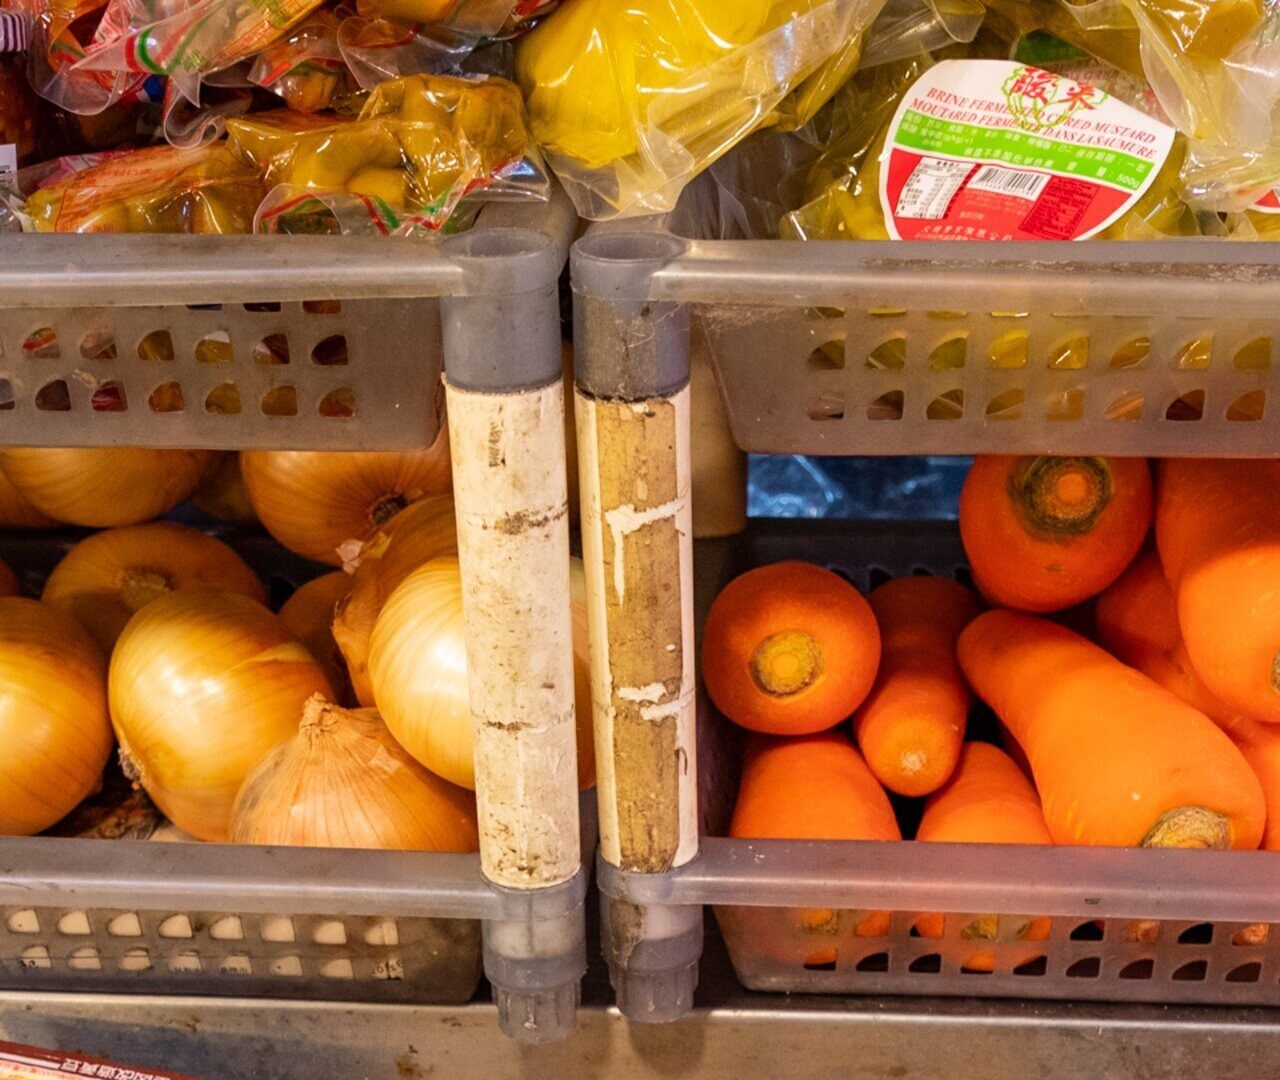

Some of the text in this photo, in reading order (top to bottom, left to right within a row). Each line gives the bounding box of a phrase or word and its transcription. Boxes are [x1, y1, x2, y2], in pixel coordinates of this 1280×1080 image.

[909, 98, 977, 122] MOUTARED
[1042, 125, 1077, 143] DANS
[926, 87, 968, 108] BRINE
[1093, 120, 1157, 144] MUSTARD
